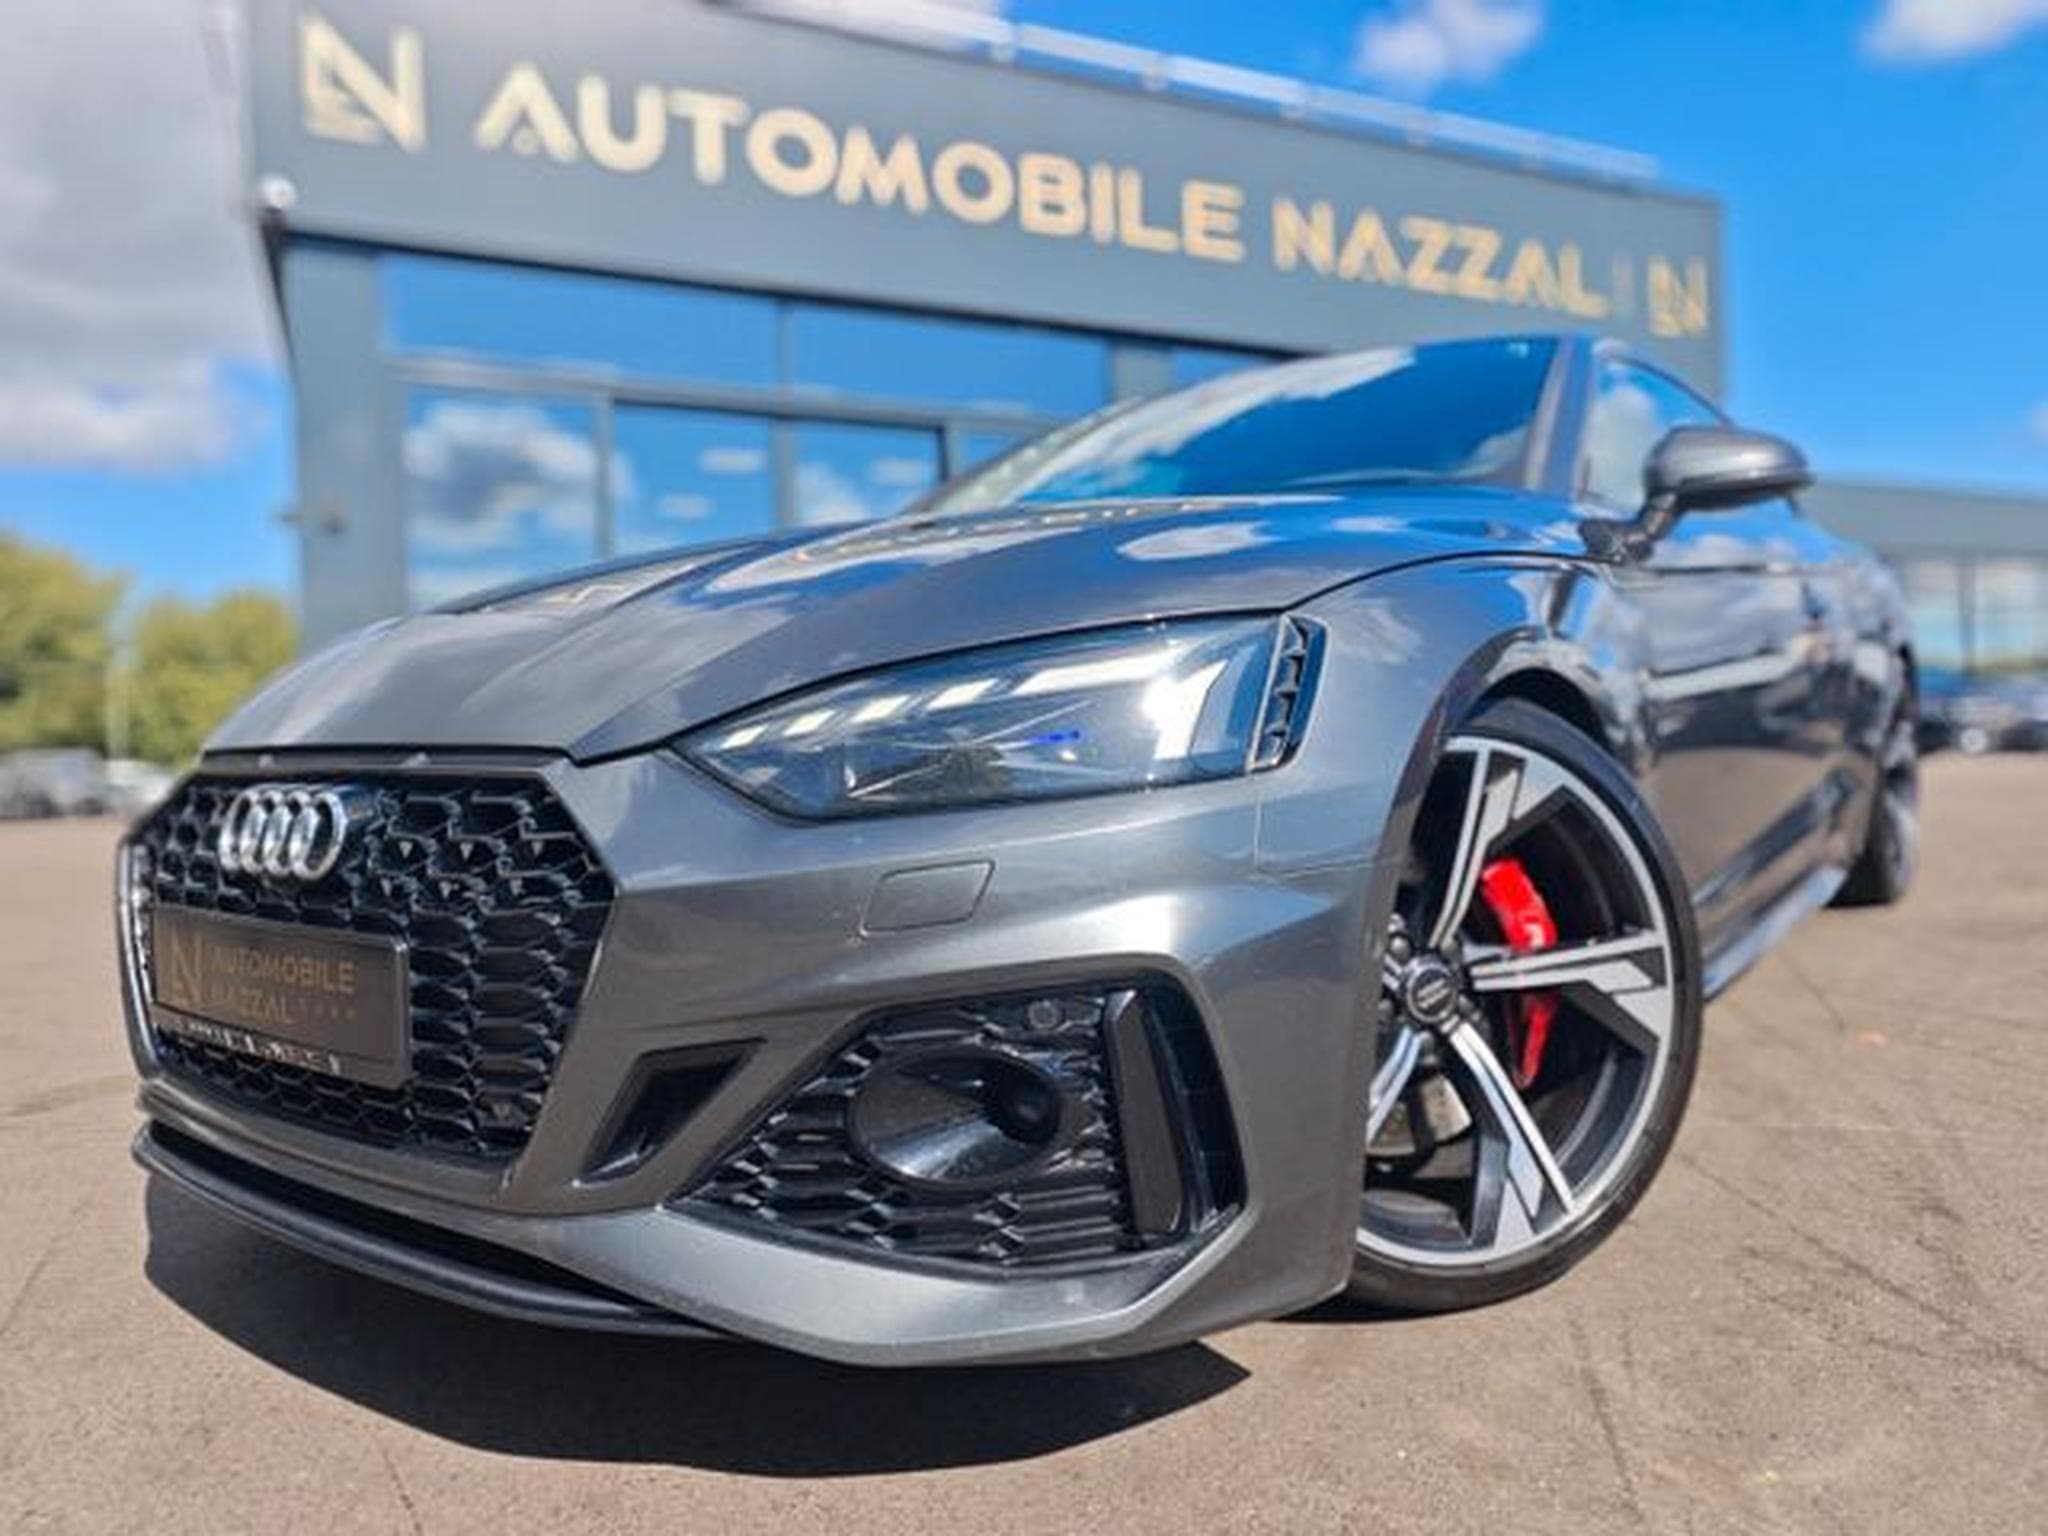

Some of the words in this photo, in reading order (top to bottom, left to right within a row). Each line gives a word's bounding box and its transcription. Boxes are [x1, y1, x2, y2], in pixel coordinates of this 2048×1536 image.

[475, 62, 1246, 262] AUTOMOBILE
[1272, 196, 1609, 318] NAZZAL
[210, 945, 357, 994] AUTOMOBILE
